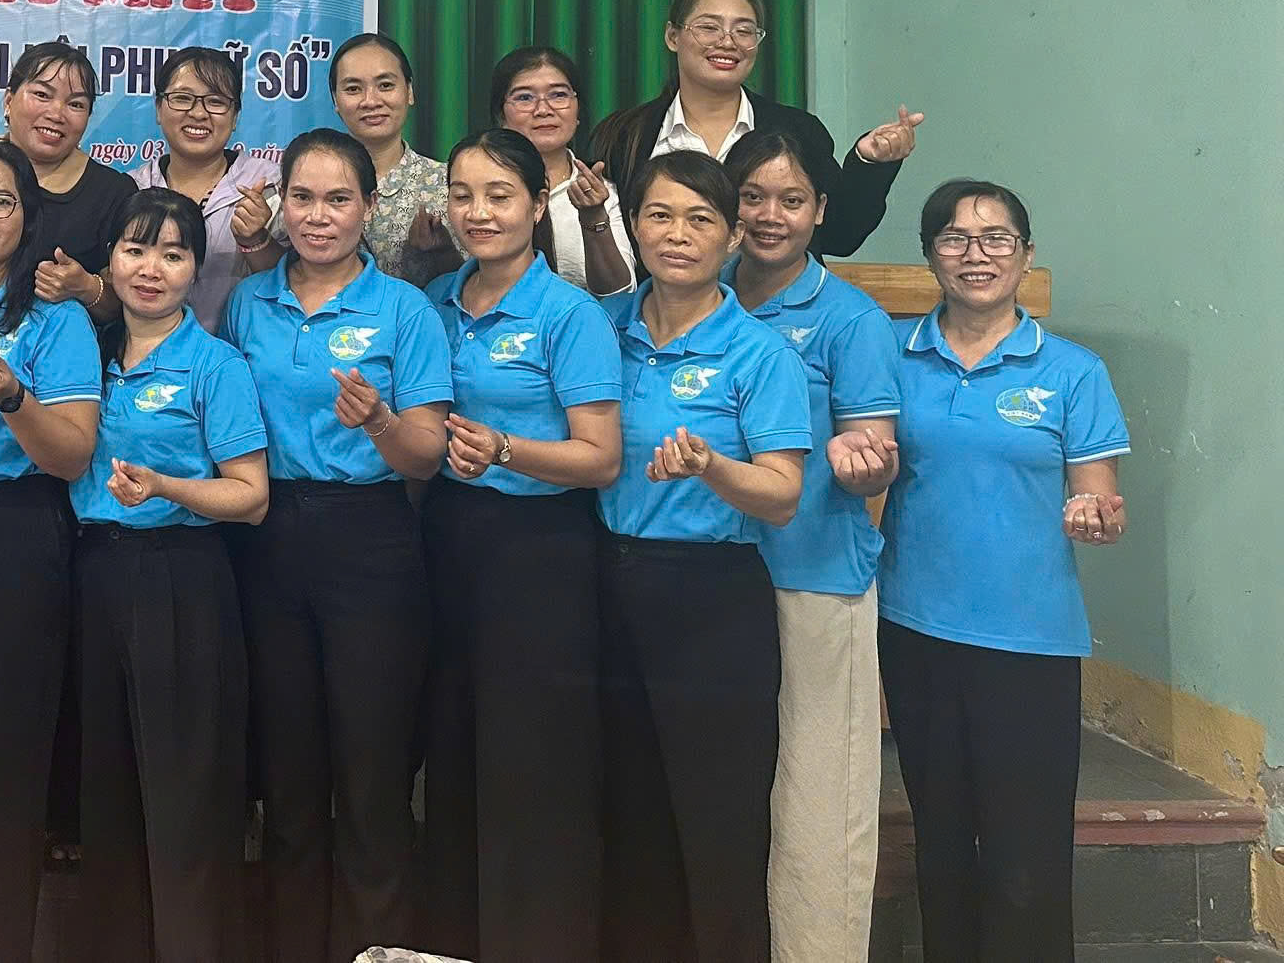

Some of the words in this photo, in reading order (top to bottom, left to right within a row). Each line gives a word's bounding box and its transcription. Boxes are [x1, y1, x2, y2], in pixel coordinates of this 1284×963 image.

[100, 46, 177, 94] PH
[91, 139, 137, 164] ngày
[142, 140, 165, 160] 03
